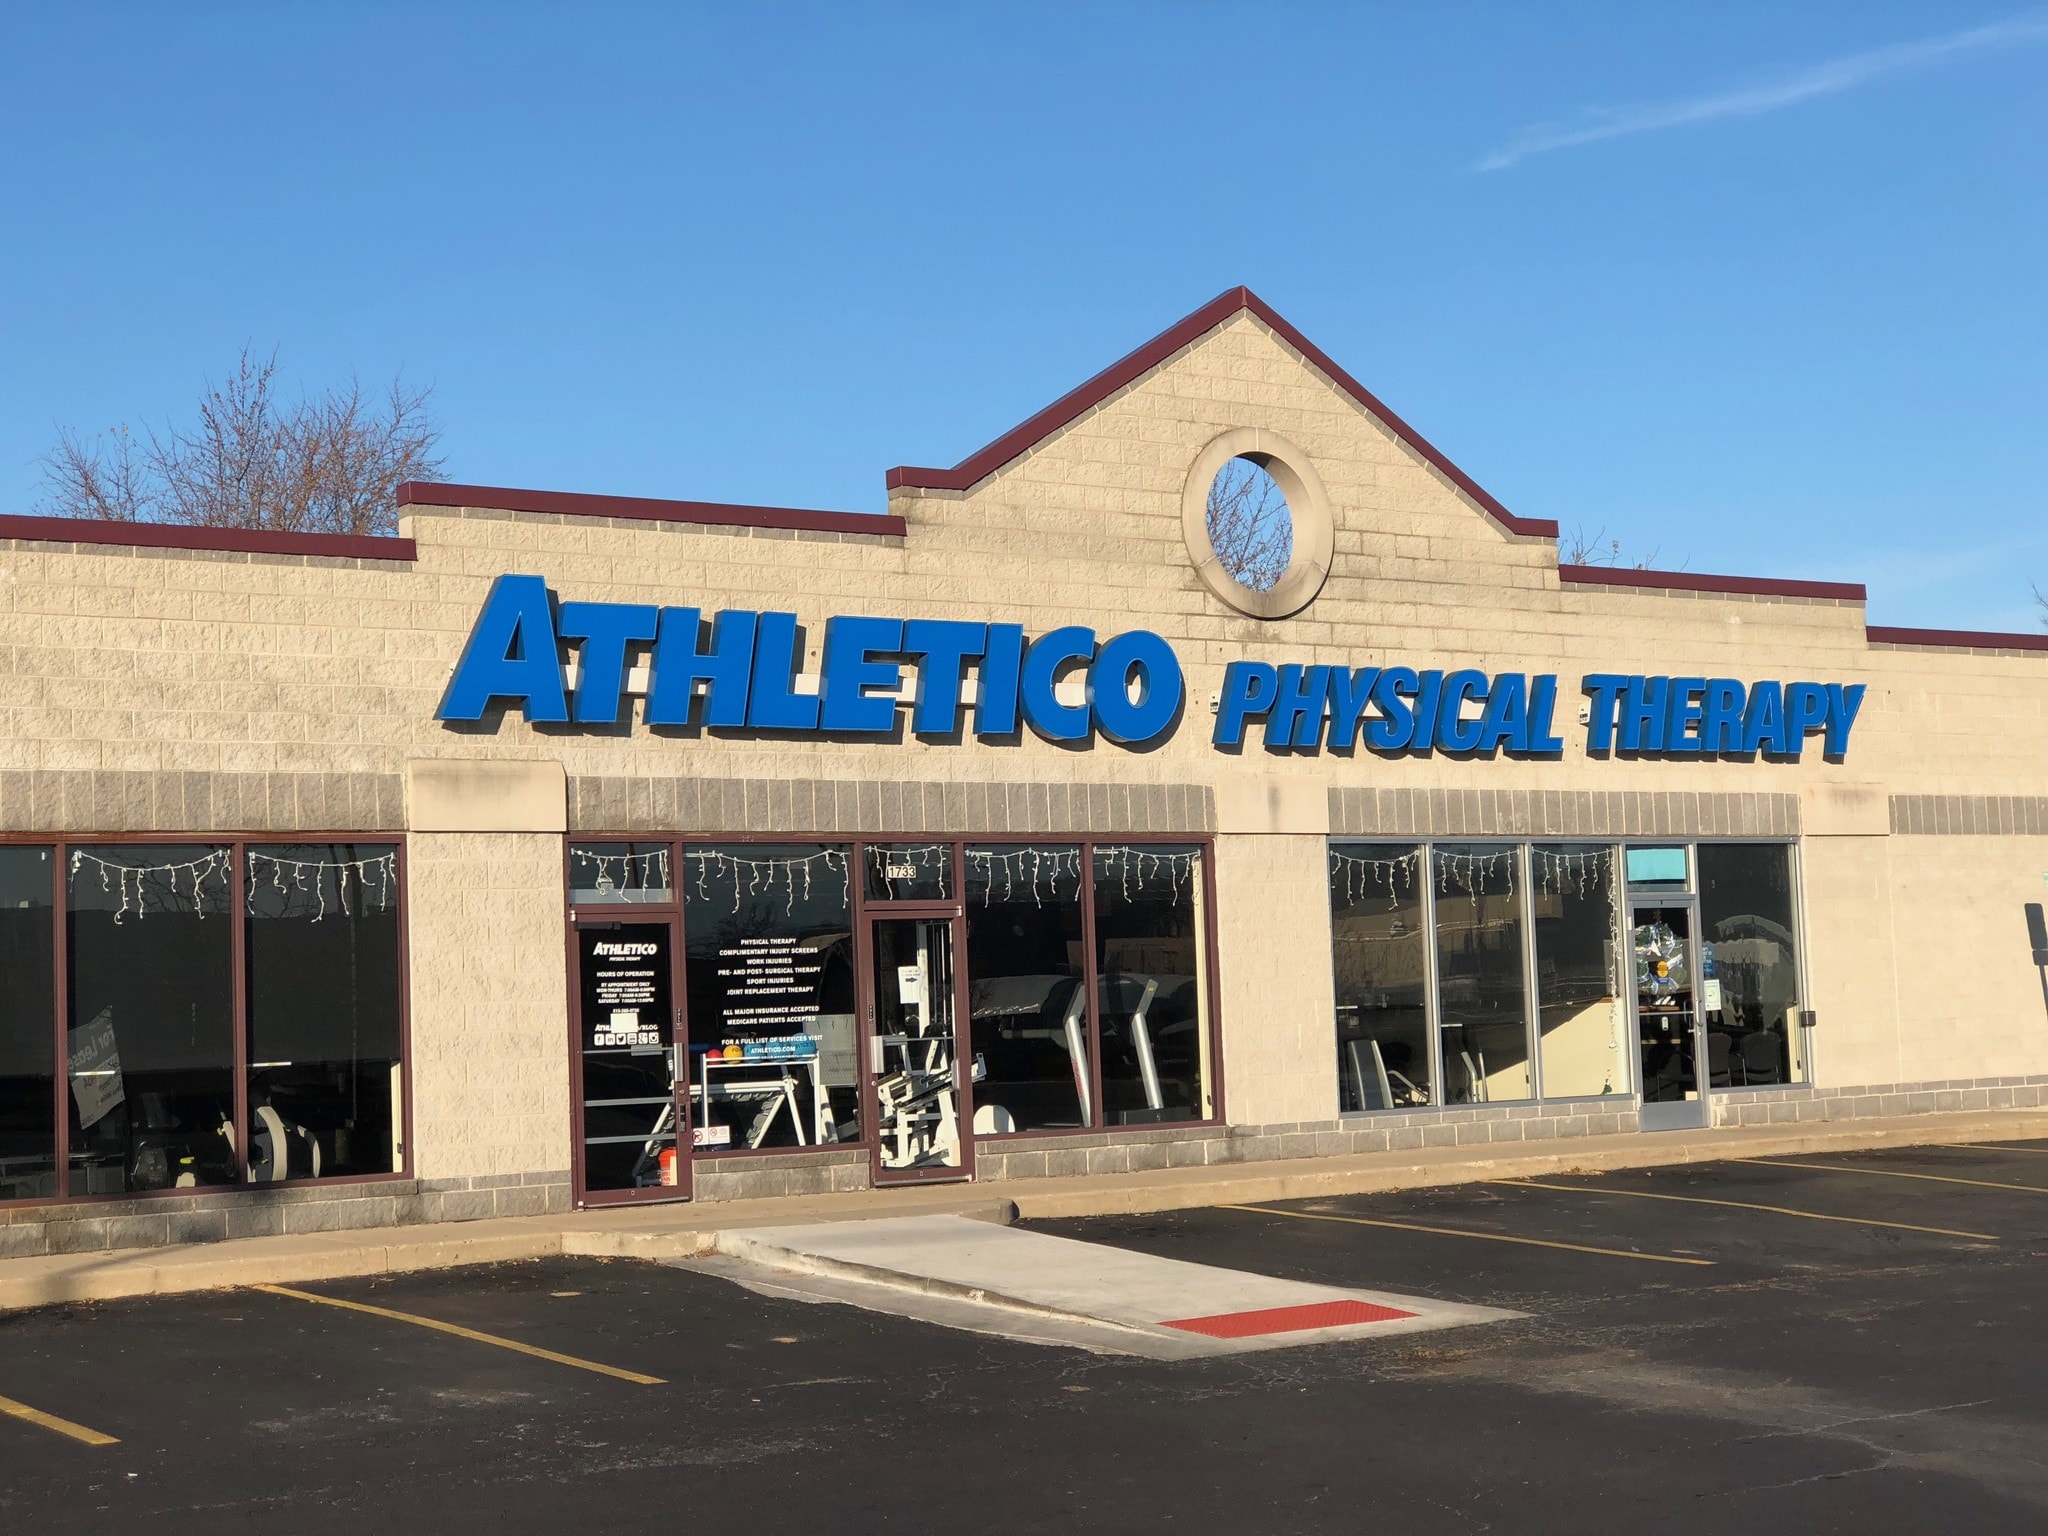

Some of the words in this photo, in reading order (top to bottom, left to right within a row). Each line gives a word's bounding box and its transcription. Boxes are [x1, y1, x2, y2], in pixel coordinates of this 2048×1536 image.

[440, 573, 1183, 742] ATHLETICO
[1211, 661, 1564, 752] PHYSICAL
[1582, 674, 1867, 757] THERAPY
[889, 866, 915, 877] 1733
[593, 942, 657, 955] ATHLETICO
